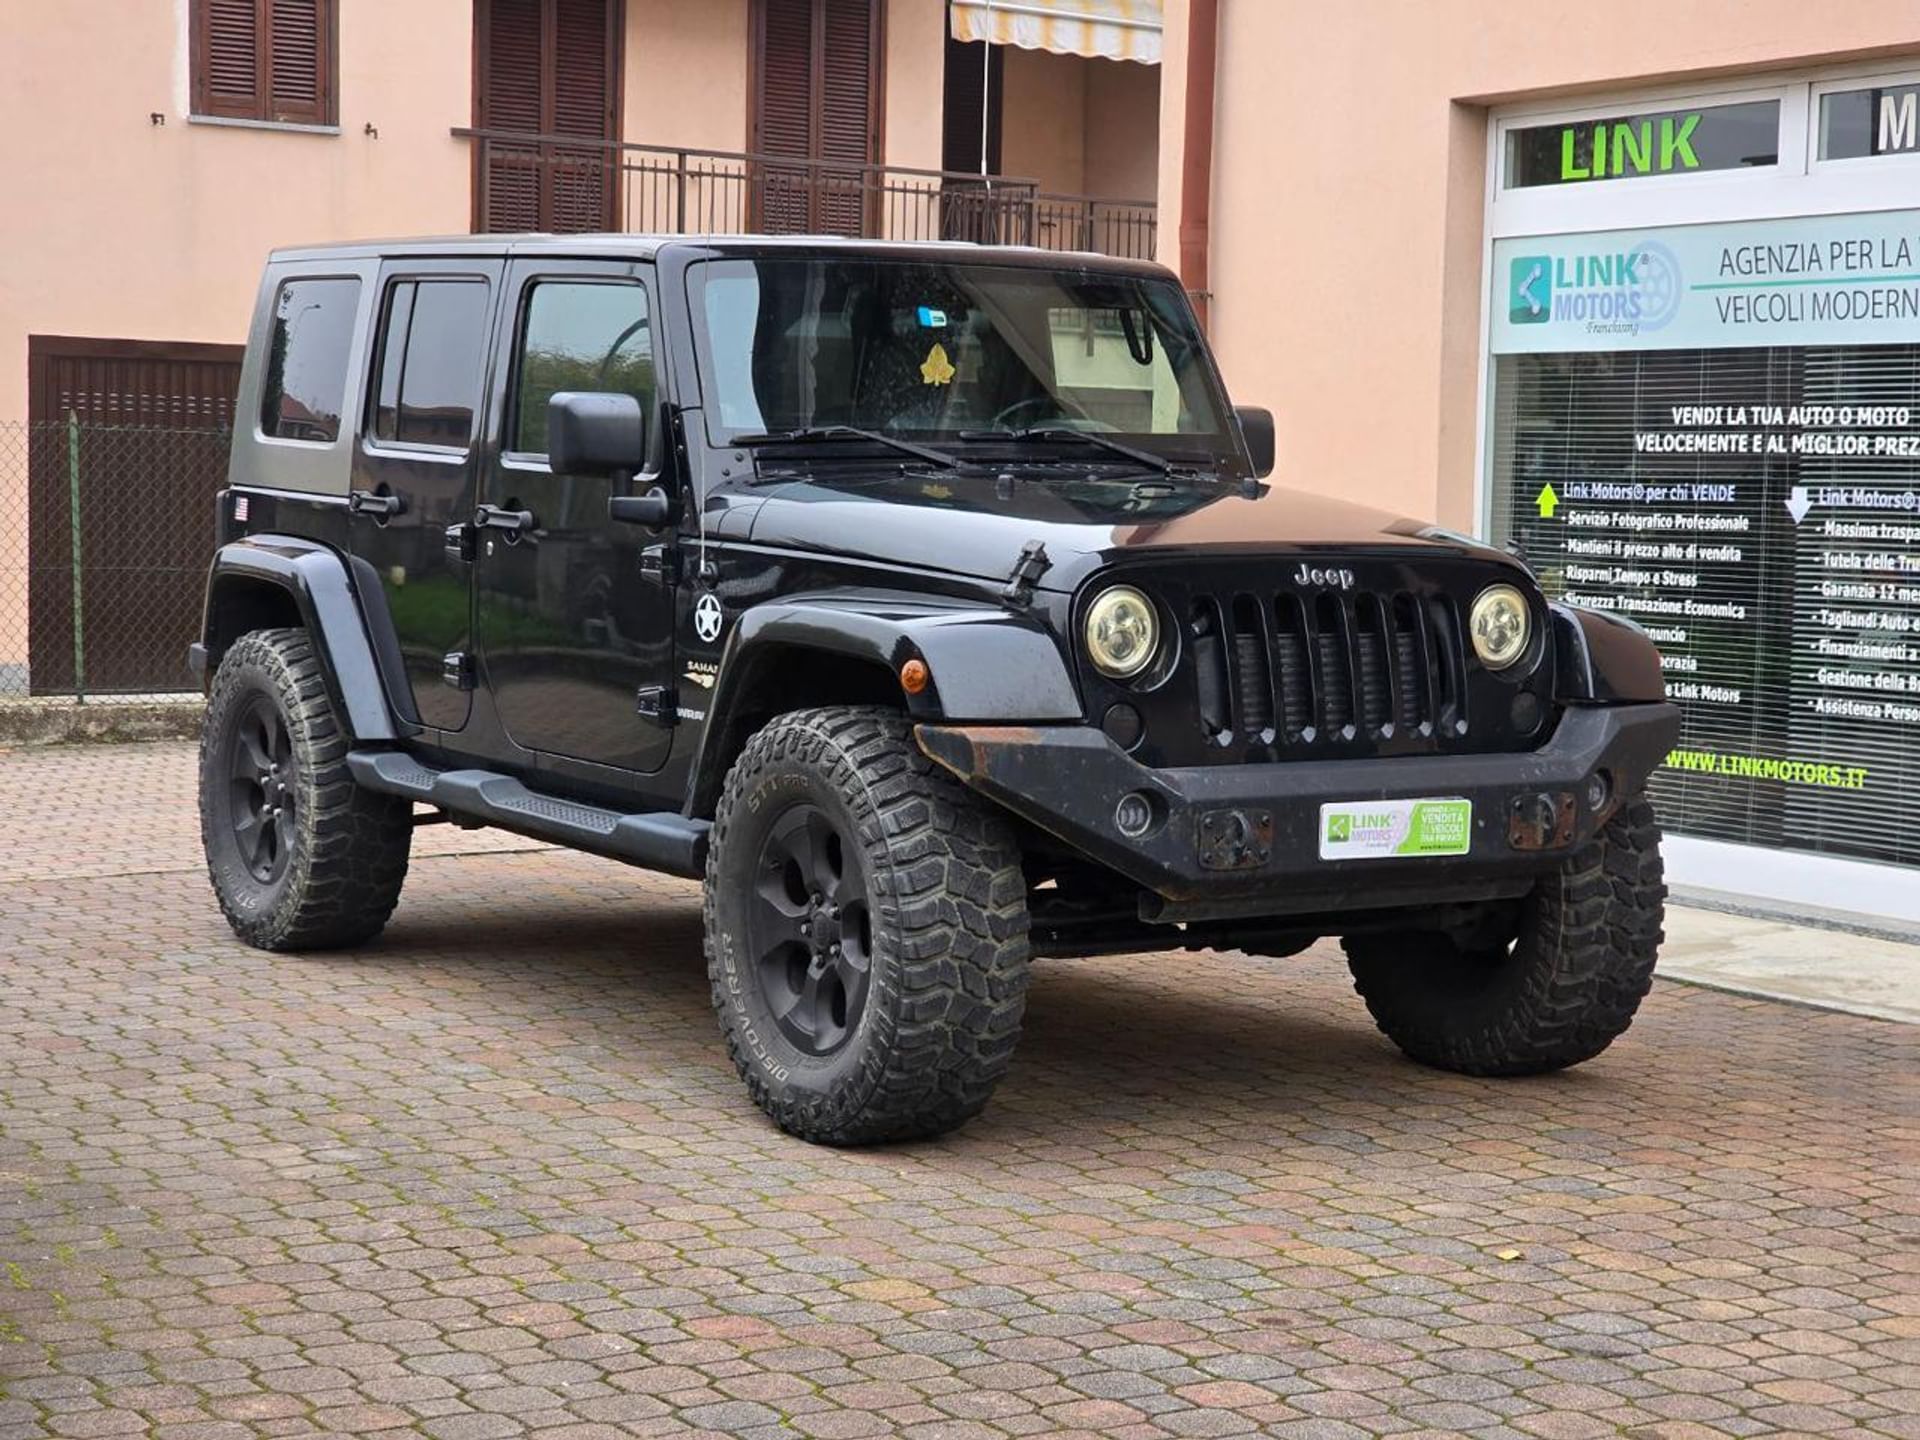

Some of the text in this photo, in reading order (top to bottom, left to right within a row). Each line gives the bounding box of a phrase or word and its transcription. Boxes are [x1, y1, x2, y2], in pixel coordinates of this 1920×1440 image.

[1878, 92, 1917, 151] M
[1561, 115, 1702, 180] LINK
[1719, 237, 1912, 277] AGENZIA PER LA
[1555, 291, 1642, 322] MOTORS
[1716, 287, 1919, 324] VEICOLI MODERN
[1672, 406, 1910, 426] VENDI LA TUA AUTO O MOTO
[1635, 434, 1920, 456] VELOCEMENTE E AL MIGLIOR PREZ
[1563, 483, 1592, 498] Link
[1646, 488, 1666, 504] per
[1670, 484, 1688, 501] chi
[1691, 485, 1736, 502] VENDE
[1819, 487, 1849, 505] Link
[1568, 511, 1750, 531] Servizio Fotografico Professionale
[1823, 520, 1878, 538] Massima
[1567, 539, 1612, 554] Mantieni
[1624, 545, 1660, 559] prezzo
[1662, 544, 1683, 560] alto
[1685, 544, 1697, 559] di
[1700, 545, 1742, 562] vendita
[1823, 551, 1861, 569] Tutela
[1864, 553, 1895, 570] delle
[1294, 563, 1354, 590] Jeep
[1566, 565, 1613, 584] Risparmi
[1614, 568, 1650, 588] Tempo
[1663, 571, 1698, 588] Stress
[1821, 581, 1876, 600] Garanzia
[1879, 583, 1896, 601] 12
[1565, 592, 1746, 620] Sicurezza Transazione Economica
[1820, 609, 1877, 630] Tagliandi
[1880, 613, 1910, 631] Auto
[1819, 639, 1906, 660] Finanziamenti
[1817, 668, 1873, 688] Gestione
[1874, 672, 1906, 691] della
[1674, 683, 1699, 699] Link
[1700, 685, 1741, 704] Motors
[1815, 698, 1881, 717] Assistenza
[1665, 750, 1869, 788] WWW.LINKMOTORS.IT
[722, 932, 790, 1082] DISCOVERER
